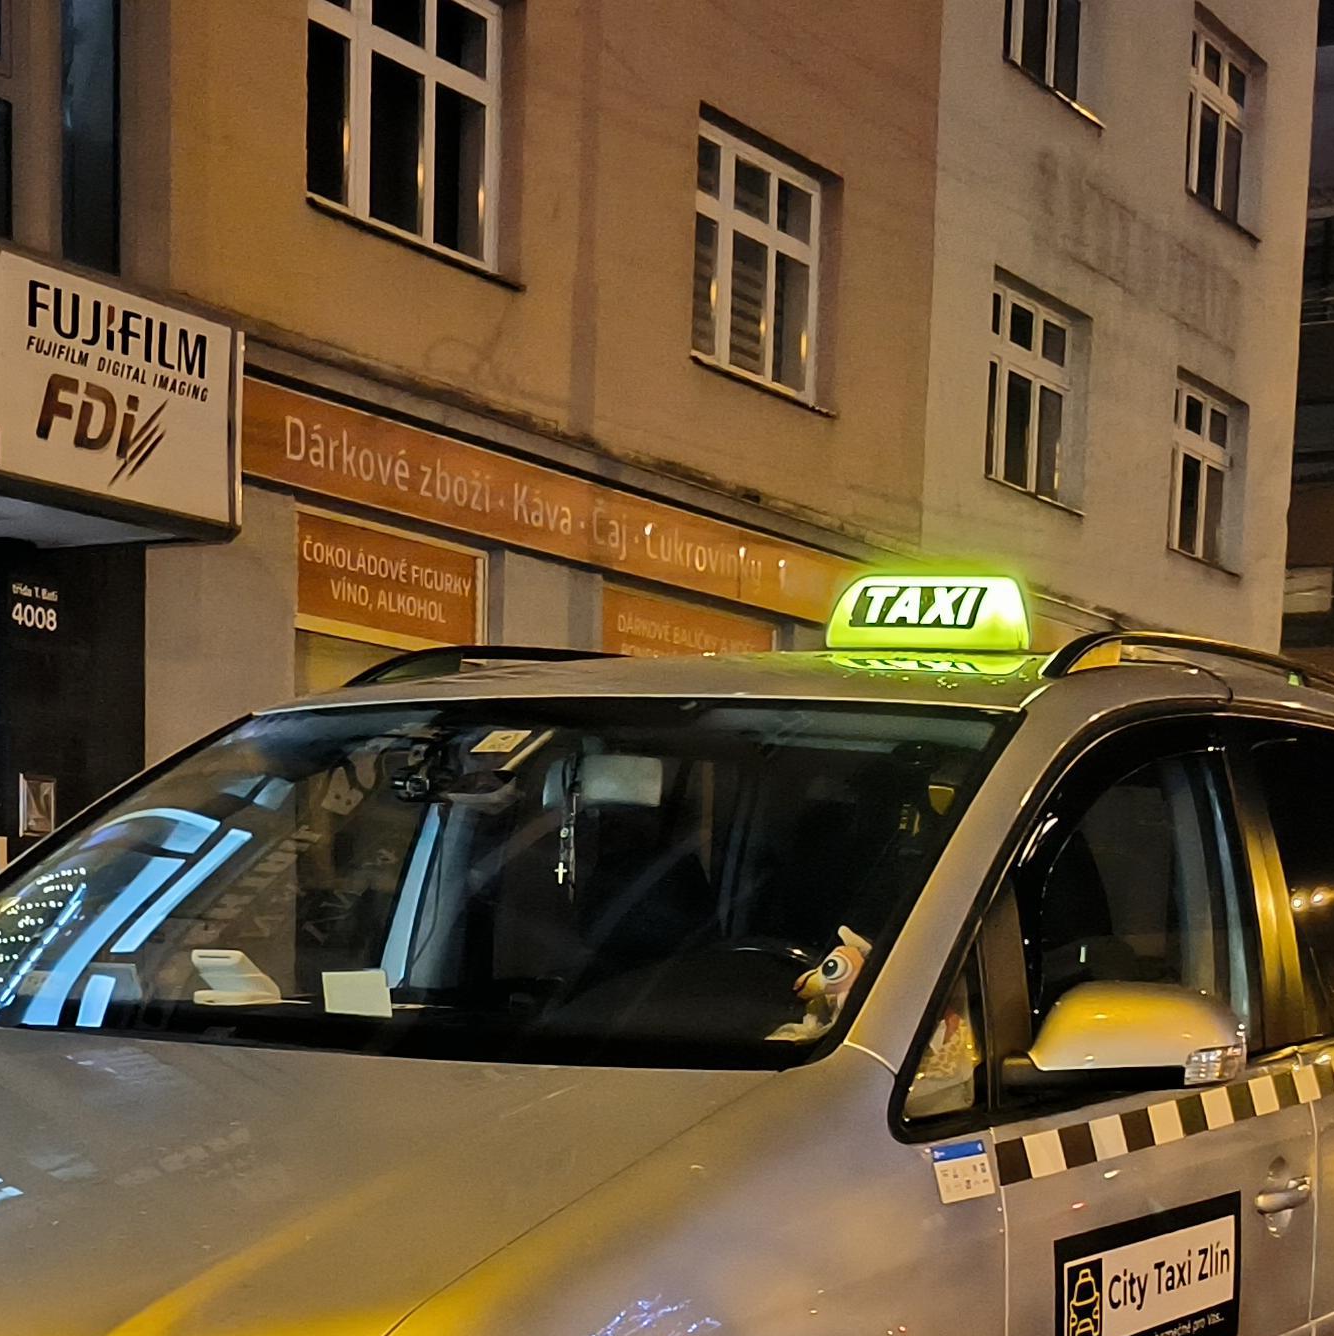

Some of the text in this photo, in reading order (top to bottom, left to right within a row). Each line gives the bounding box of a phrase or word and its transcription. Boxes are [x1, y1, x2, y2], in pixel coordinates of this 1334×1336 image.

[27, 279, 208, 379] FUJIFILM
[26, 335, 210, 403] FUJIFILM DIGITAL IMAGING
[284, 415, 411, 492] Dárkové
[419, 458, 492, 513] zboží
[513, 482, 572, 535] Káva
[592, 499, 628, 561] Čaj
[302, 534, 472, 598] ČOKOLÁDOVÉ FIGURKY
[11, 602, 58, 632] 4008
[330, 576, 446, 623] VÍNO, ALKOHOL
[864, 586, 981, 626] TAXI
[1108, 1240, 1230, 1311] City Taxi Zlín
